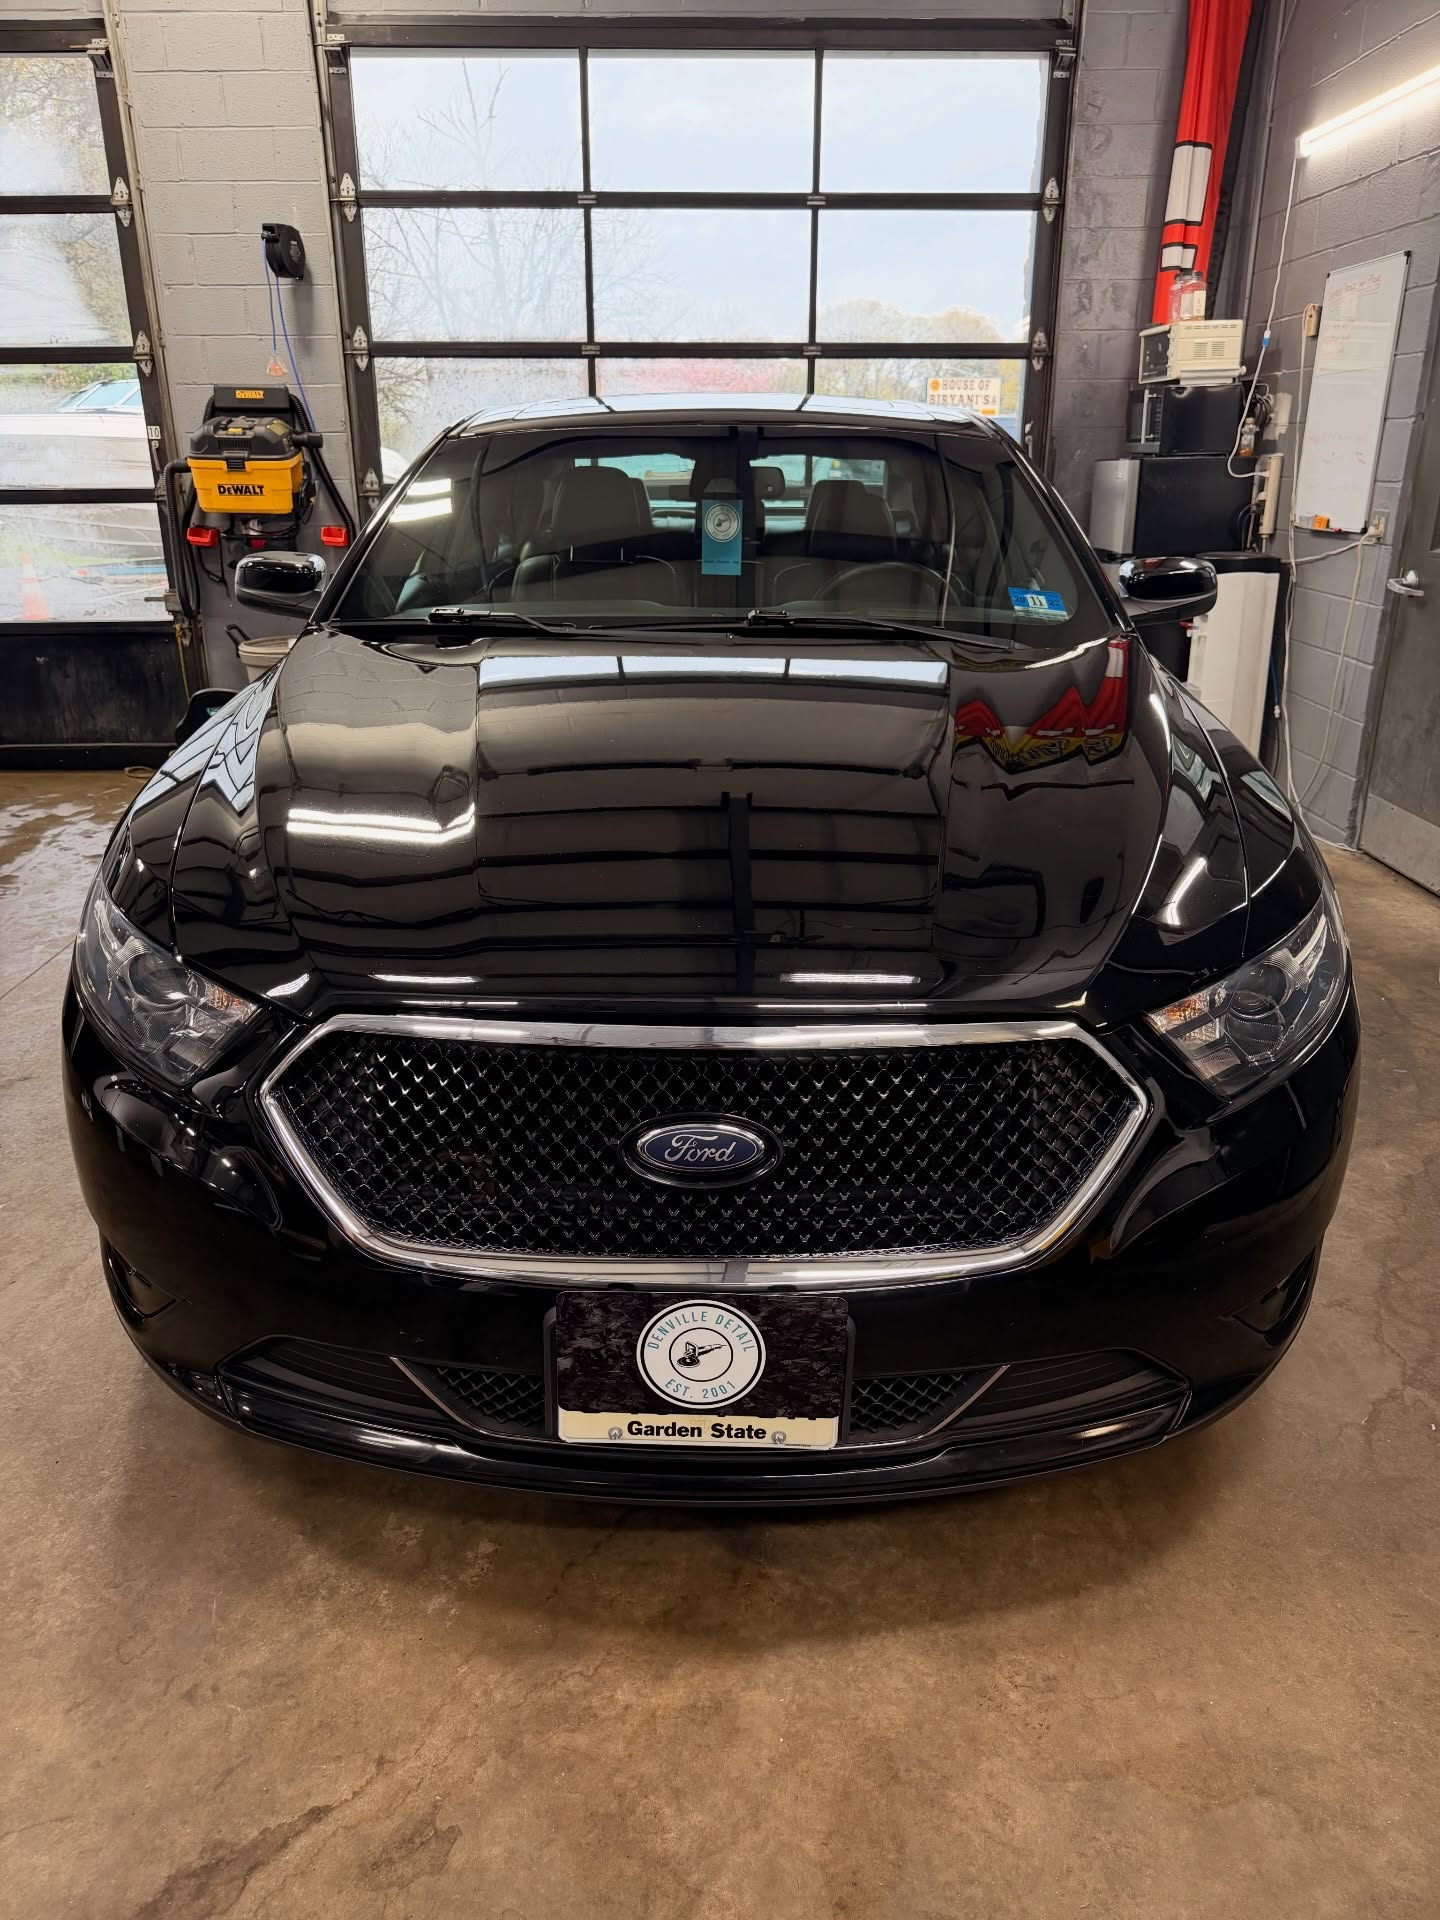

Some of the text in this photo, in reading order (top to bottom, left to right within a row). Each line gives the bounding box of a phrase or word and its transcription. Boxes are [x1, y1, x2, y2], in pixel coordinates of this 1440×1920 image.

[942, 379, 991, 391] HOUSE OF
[148, 427, 160, 438] 10
[217, 485, 265, 496] DEWALT
[664, 1134, 737, 1162] Ford
[647, 1311, 756, 1352] DENVILLE DETAIL
[665, 1379, 736, 1399] EST. 2001
[627, 1420, 767, 1440] Garden State
